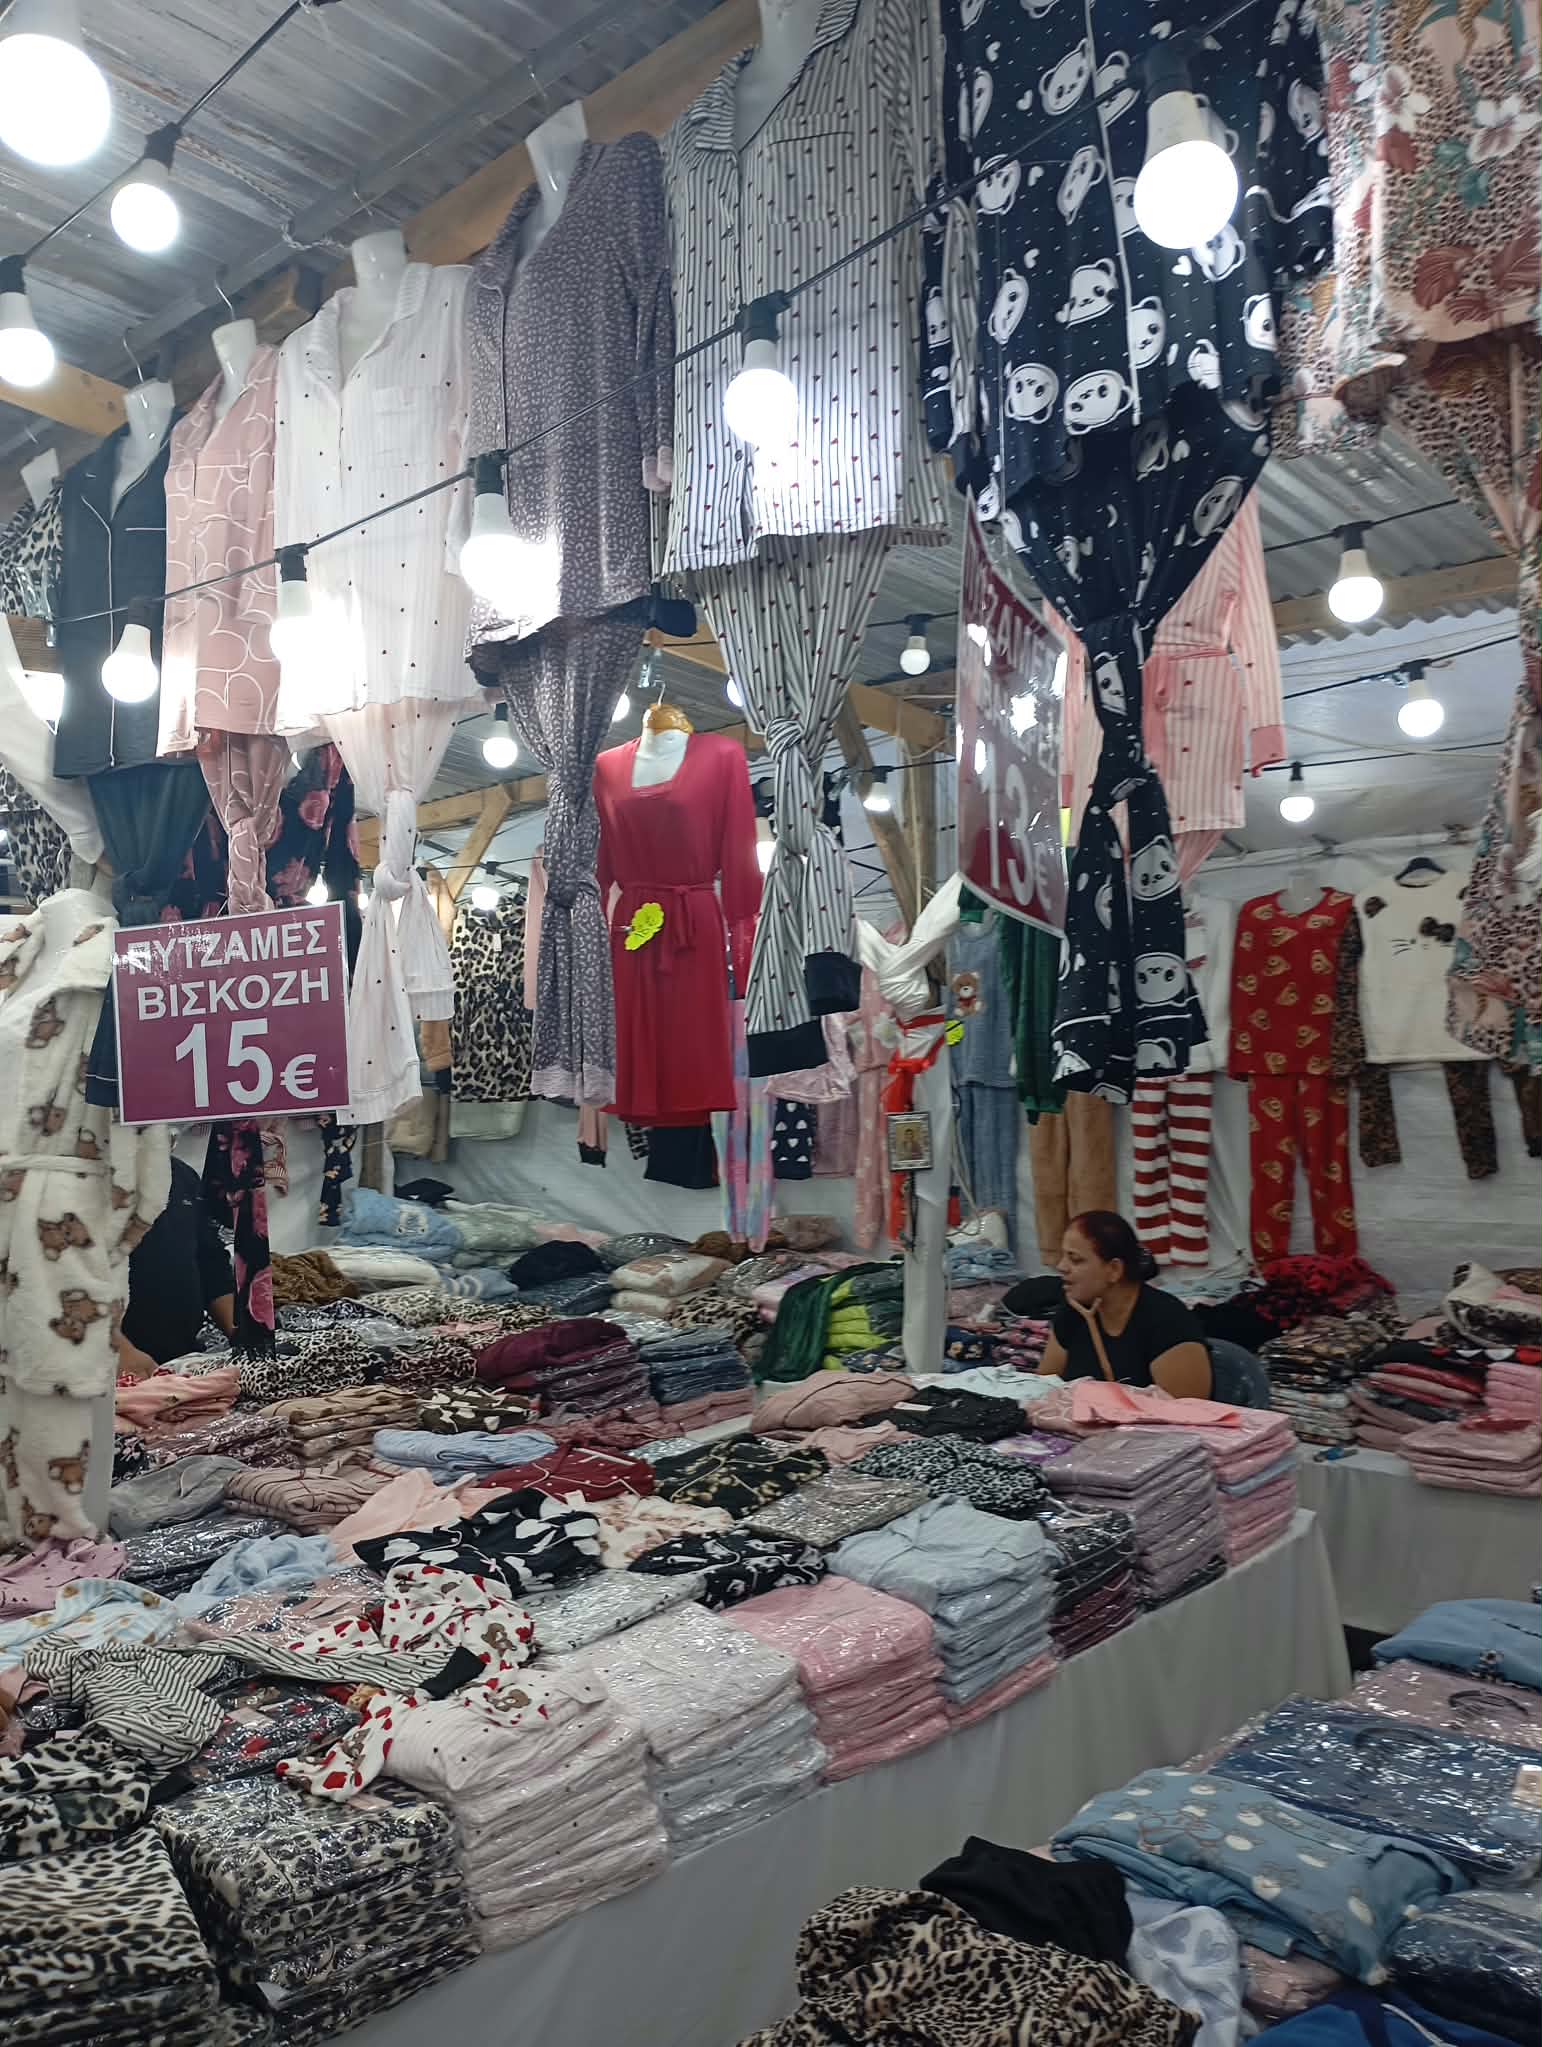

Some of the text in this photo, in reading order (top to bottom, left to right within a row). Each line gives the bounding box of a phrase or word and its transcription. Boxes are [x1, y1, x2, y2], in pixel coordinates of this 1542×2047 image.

[127, 919, 328, 975] ΠΥΤΖΑΜΕΣ
[137, 967, 330, 1021] ΒΙΣΚΟΖΗ
[175, 1017, 319, 1109] 15€
